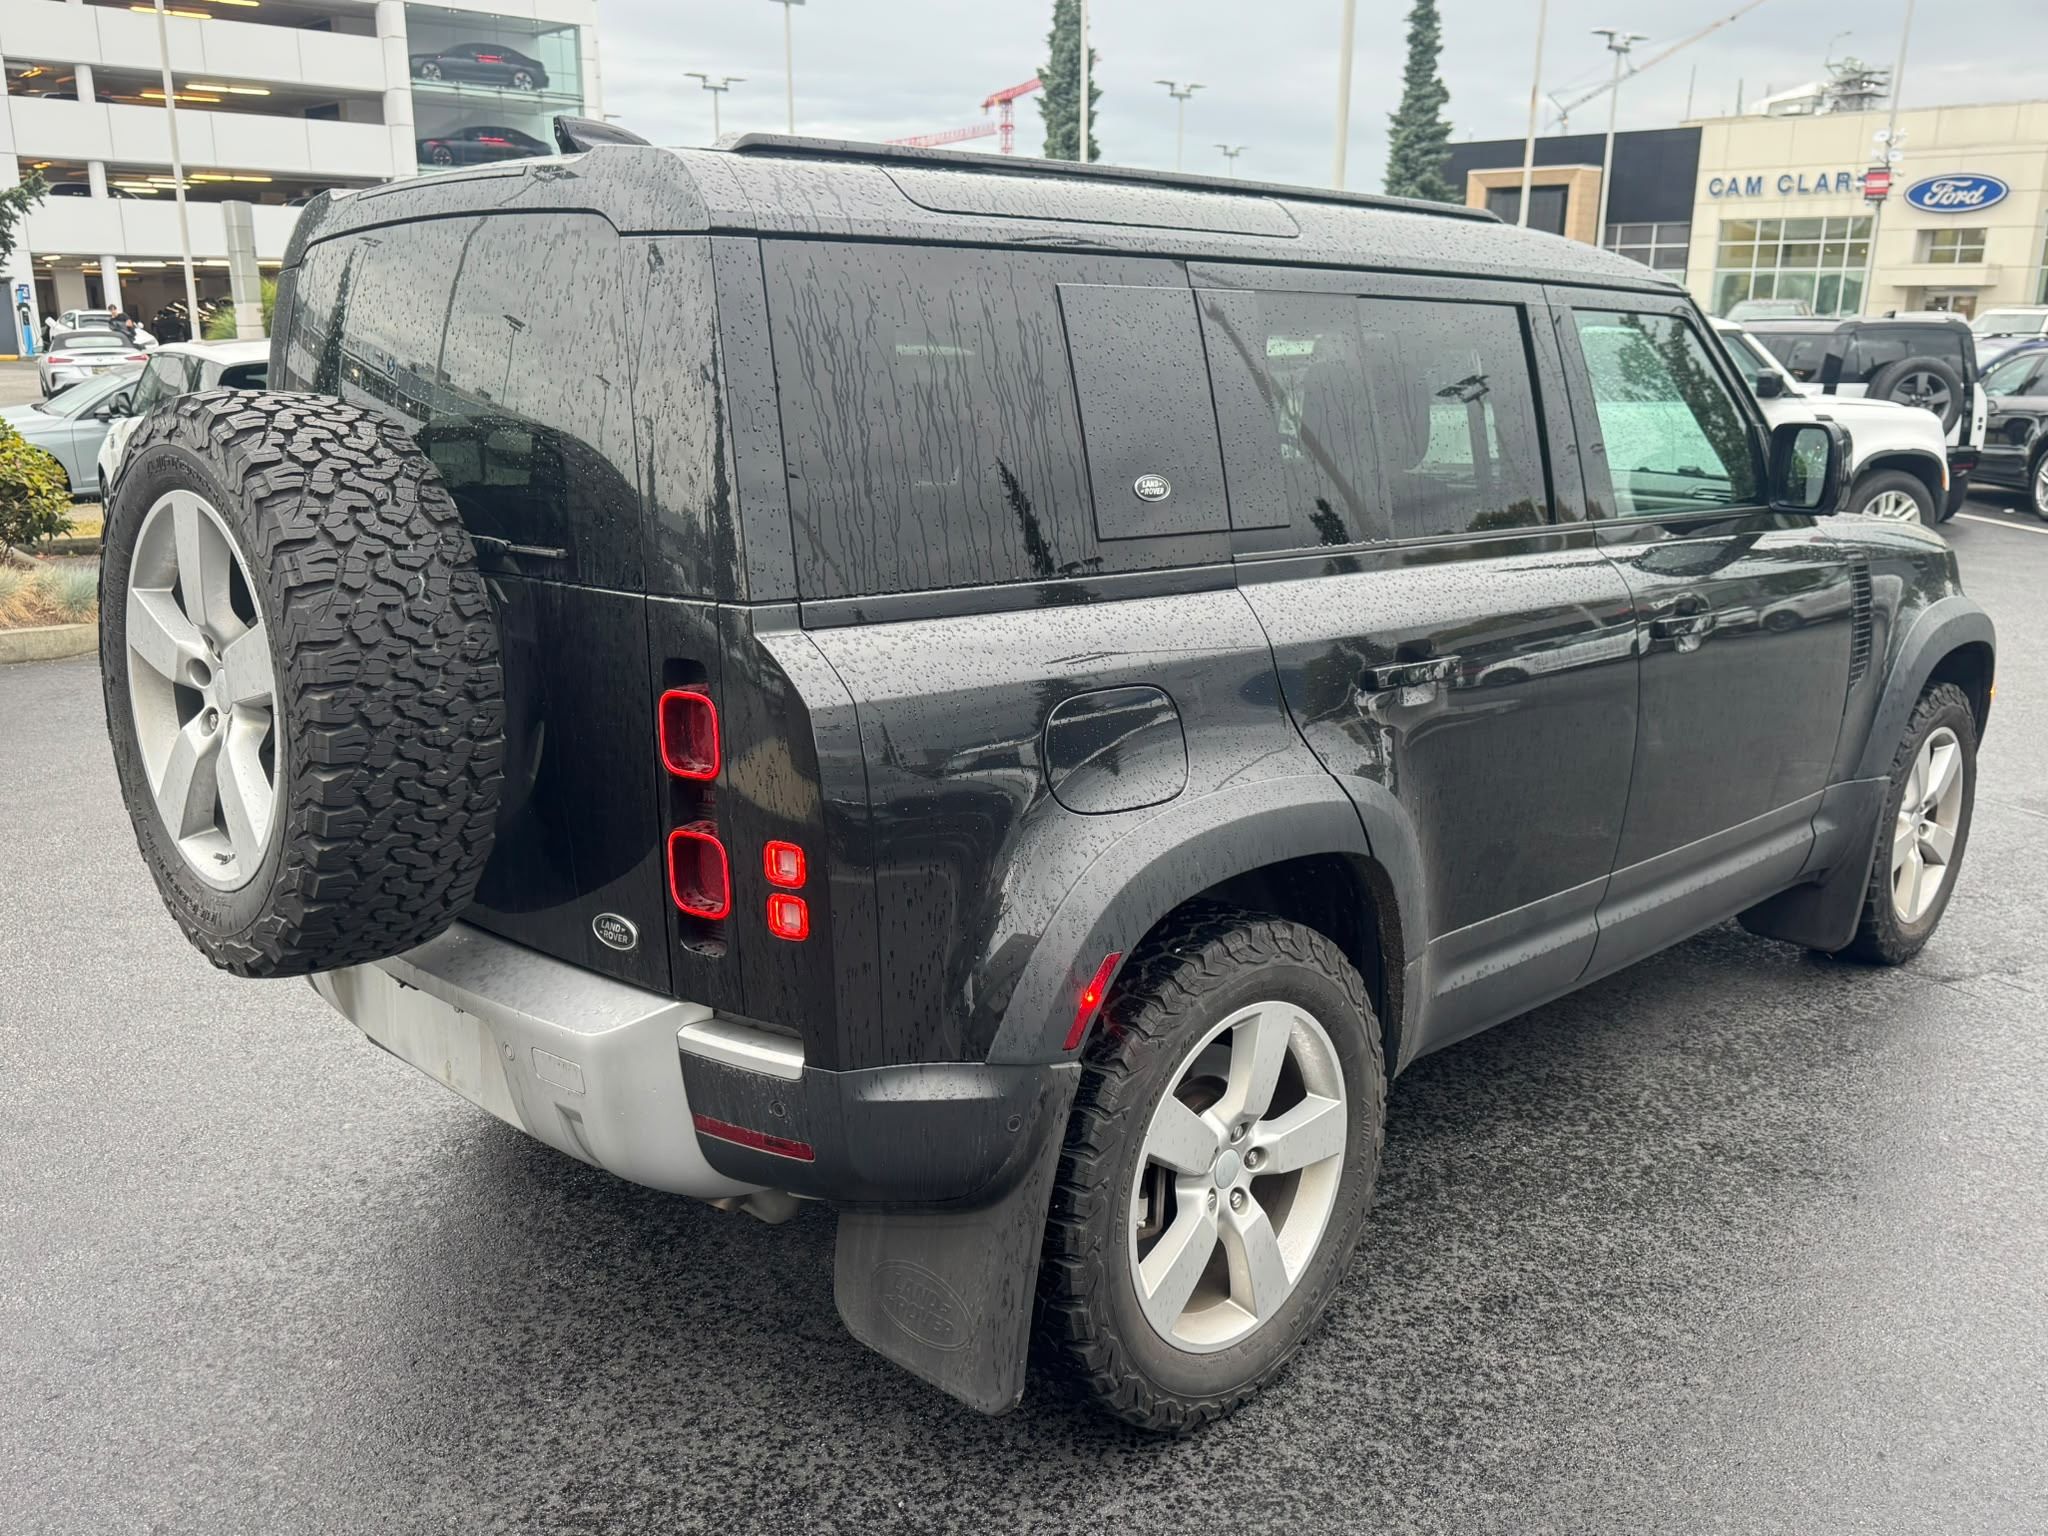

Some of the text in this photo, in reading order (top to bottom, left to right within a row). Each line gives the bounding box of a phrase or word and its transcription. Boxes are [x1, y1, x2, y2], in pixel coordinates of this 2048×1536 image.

[1709, 176, 1763, 198] CAM
[1923, 180, 1987, 206] Ford
[1142, 480, 1159, 488] LAND
[1144, 487, 1164, 495] ROVER
[601, 920, 621, 933] LAND
[603, 930, 628, 944] ROVER
